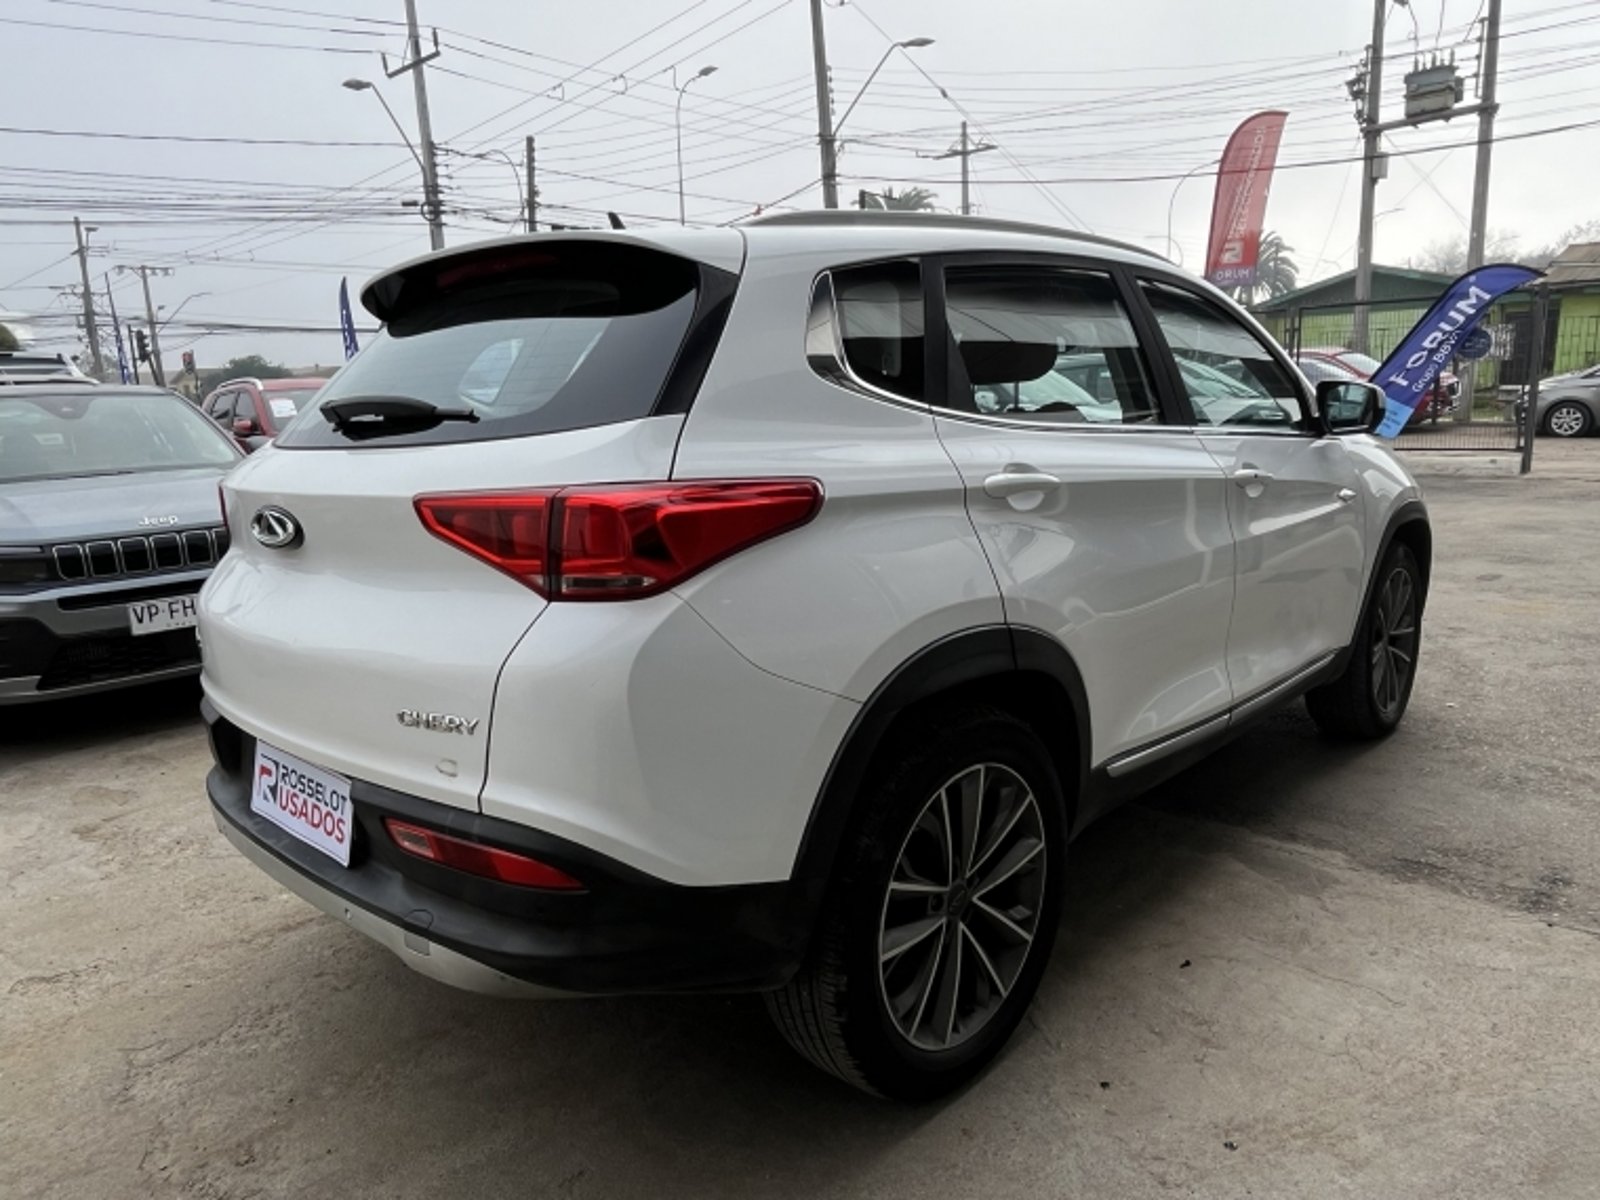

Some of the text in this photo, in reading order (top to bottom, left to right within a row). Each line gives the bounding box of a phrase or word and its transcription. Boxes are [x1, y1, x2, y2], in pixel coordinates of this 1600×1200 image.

[1215, 268, 1249, 281] ORUM
[1389, 285, 1491, 387] FORUM
[1411, 329, 1463, 393] Grupo BBVA
[139, 515, 179, 526] Jeep
[397, 708, 480, 736] CHERY
[279, 785, 346, 845] USADOS
[280, 763, 348, 816] ROSSELOT
